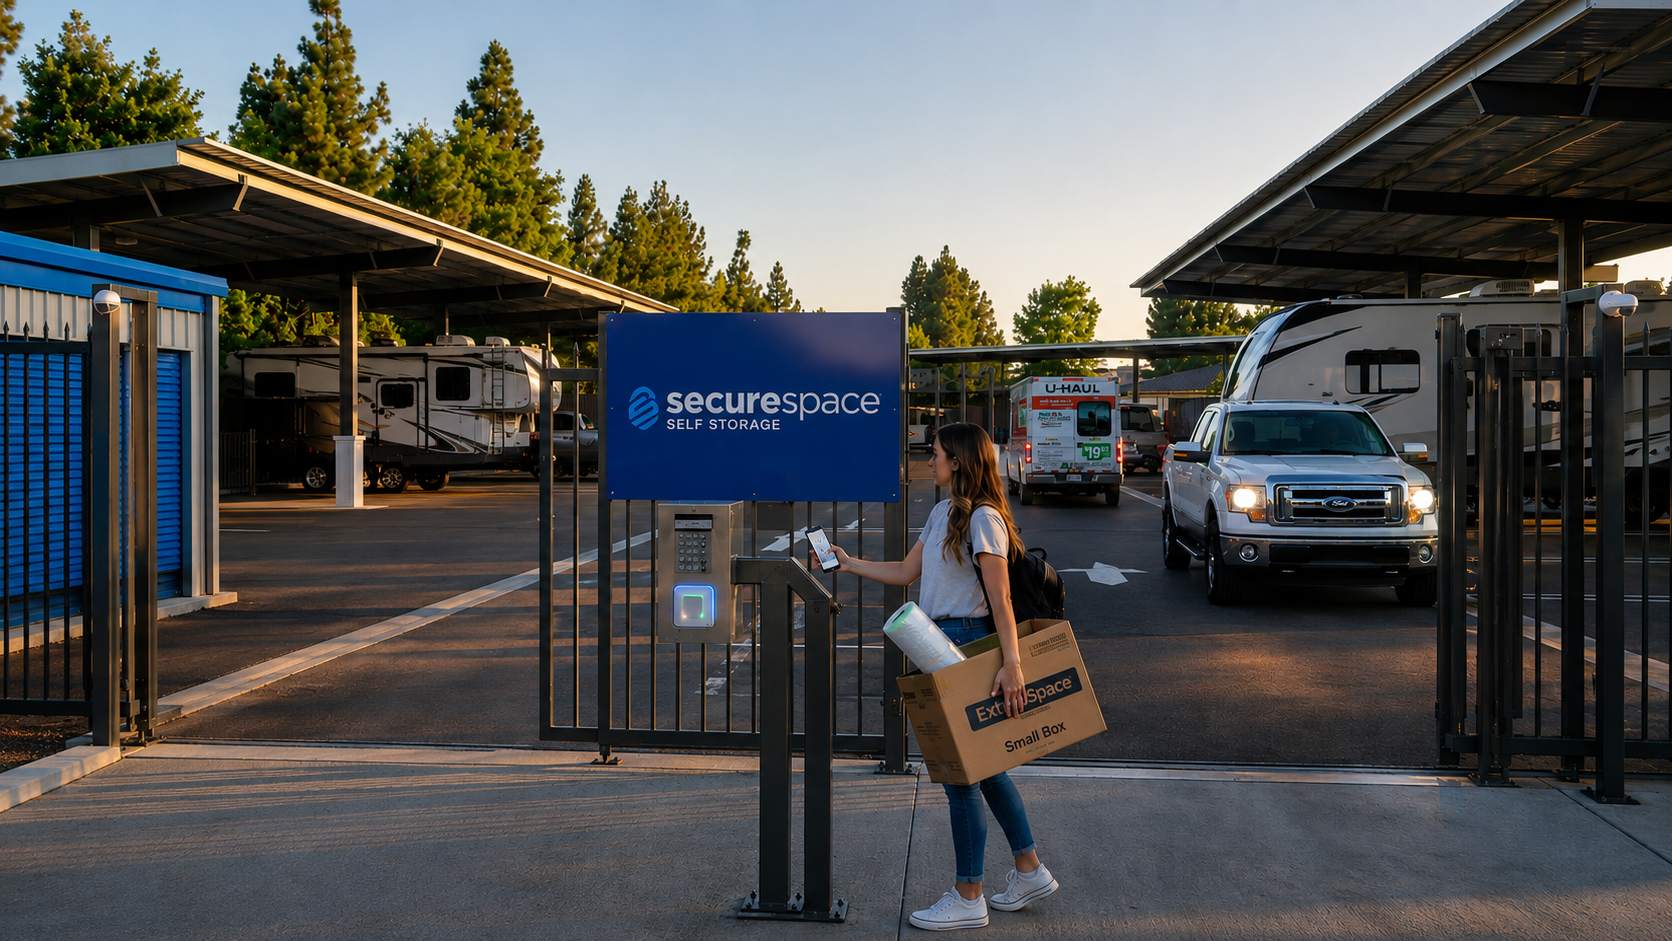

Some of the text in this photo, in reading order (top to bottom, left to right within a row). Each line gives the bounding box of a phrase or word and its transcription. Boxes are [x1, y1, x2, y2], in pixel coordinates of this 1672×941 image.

[1046, 384, 1100, 393] U-HAUL
[666, 391, 880, 421] securespace
[666, 419, 780, 430] SELF STORAGE
[975, 677, 1072, 722] ExtSpace
[1004, 730, 1040, 753] Small
[1044, 721, 1066, 739] Box
